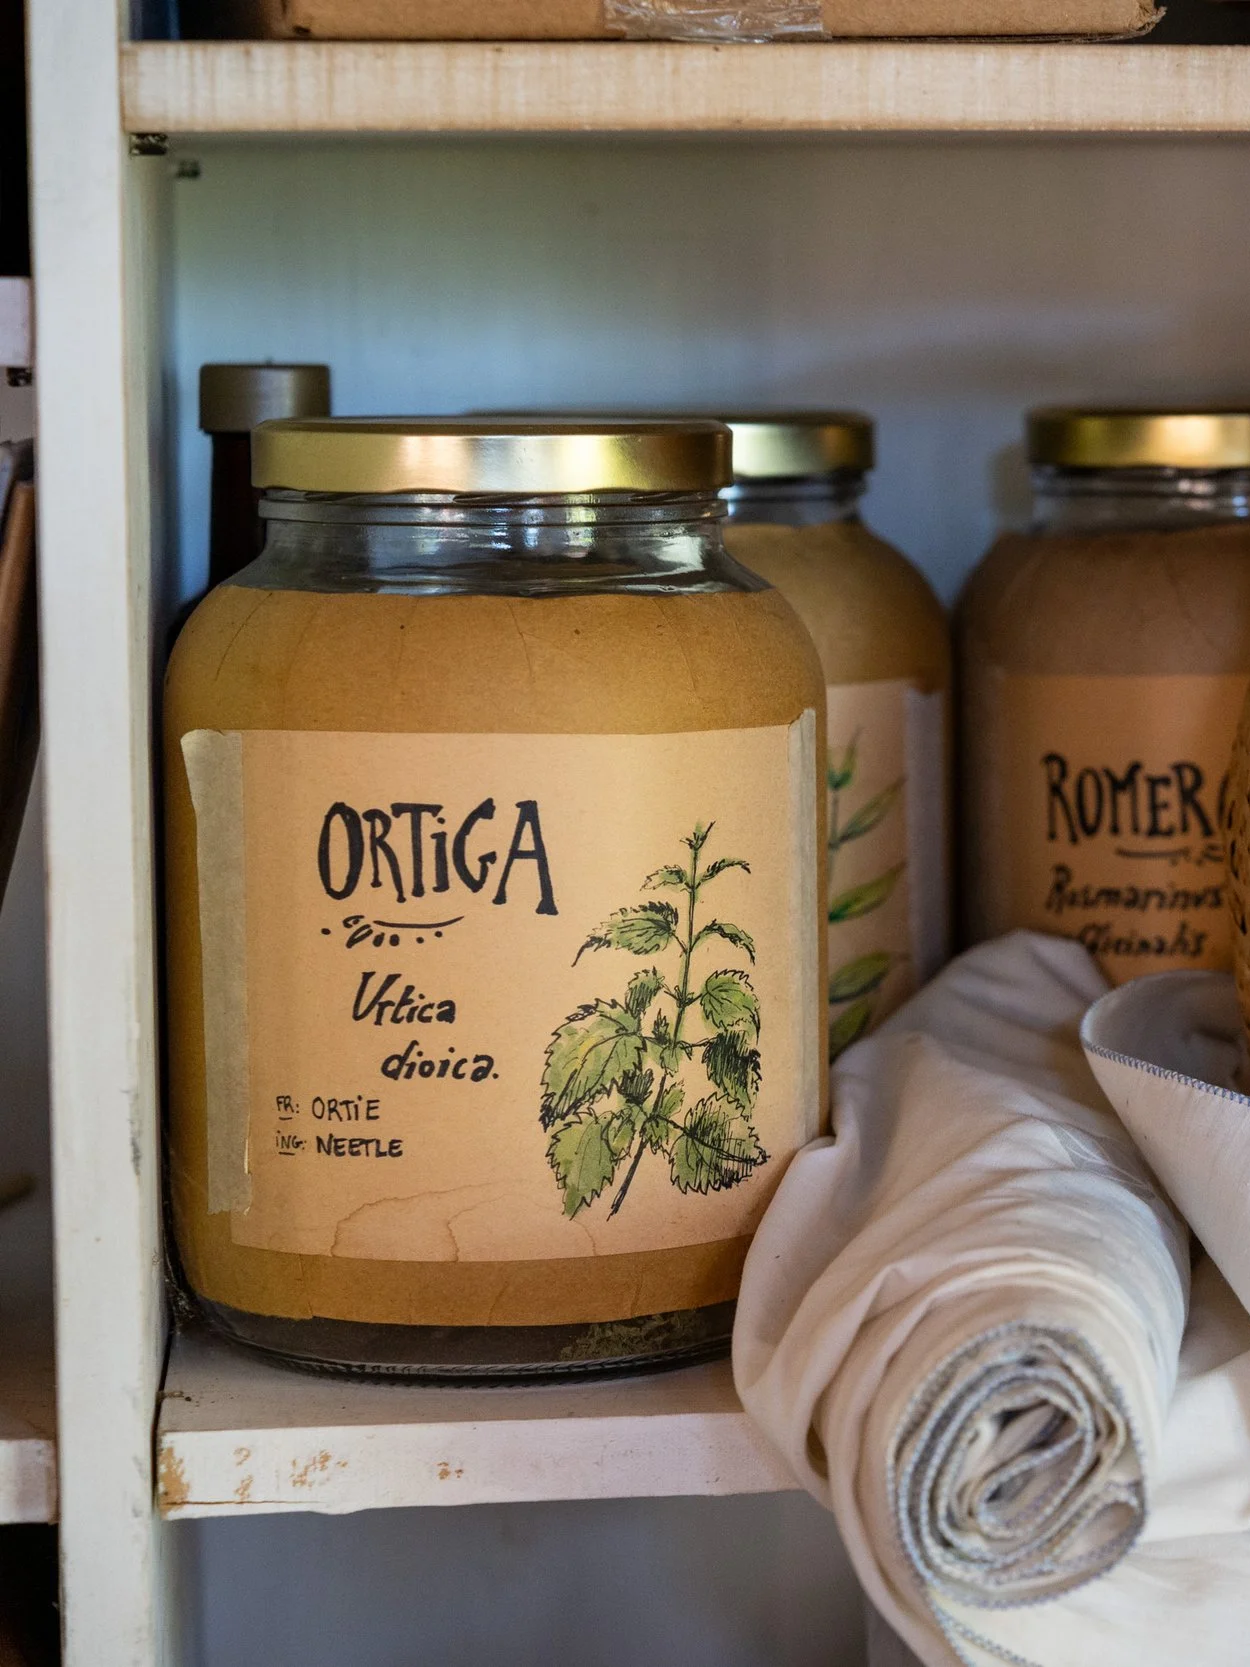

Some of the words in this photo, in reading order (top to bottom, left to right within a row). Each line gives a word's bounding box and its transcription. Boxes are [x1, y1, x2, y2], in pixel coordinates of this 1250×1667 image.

[1042, 752, 1230, 844] ROMER
[352, 971, 456, 1026] Urtica
[380, 1039, 499, 1082] dioica.
[315, 1133, 403, 1158] NEETLE
